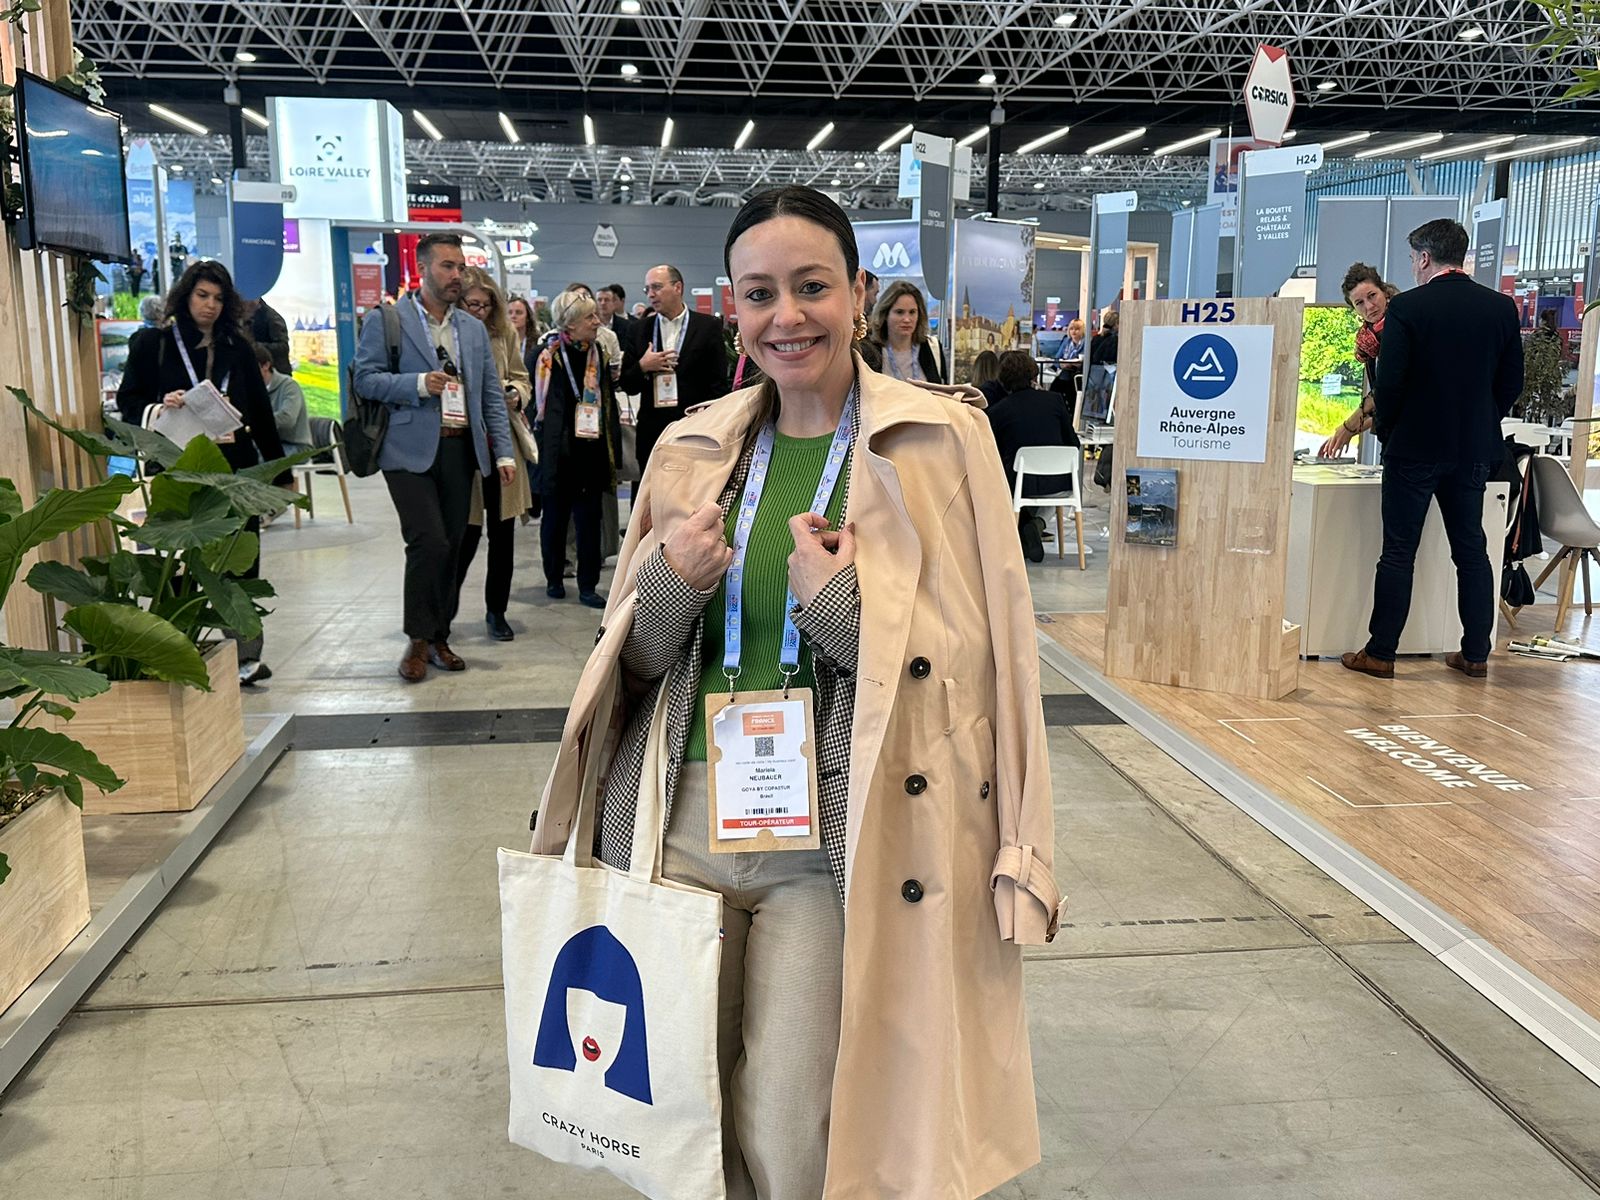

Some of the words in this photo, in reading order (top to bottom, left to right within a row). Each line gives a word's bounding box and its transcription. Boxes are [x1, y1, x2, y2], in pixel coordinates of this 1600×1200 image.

[1252, 86, 1289, 107] CORSICA
[1297, 154, 1317, 165] H24
[327, 167, 371, 178] VALLEY
[1256, 208, 1264, 216] LA
[1265, 205, 1292, 215] BOUITTE
[1260, 215, 1282, 224] RELAIS
[1282, 214, 1288, 222] &
[1182, 302, 1235, 323] H25
[1170, 406, 1236, 421] Auvergne
[1160, 421, 1245, 436] Rhône-Alpes
[1172, 436, 1231, 450] Tourisme
[1344, 728, 1478, 788] WELCOME
[1378, 724, 1533, 791] BIENVENUE
[542, 1111, 585, 1138] CRAZY
[590, 1131, 641, 1158] HORSE
[581, 1143, 605, 1158] PARIS
